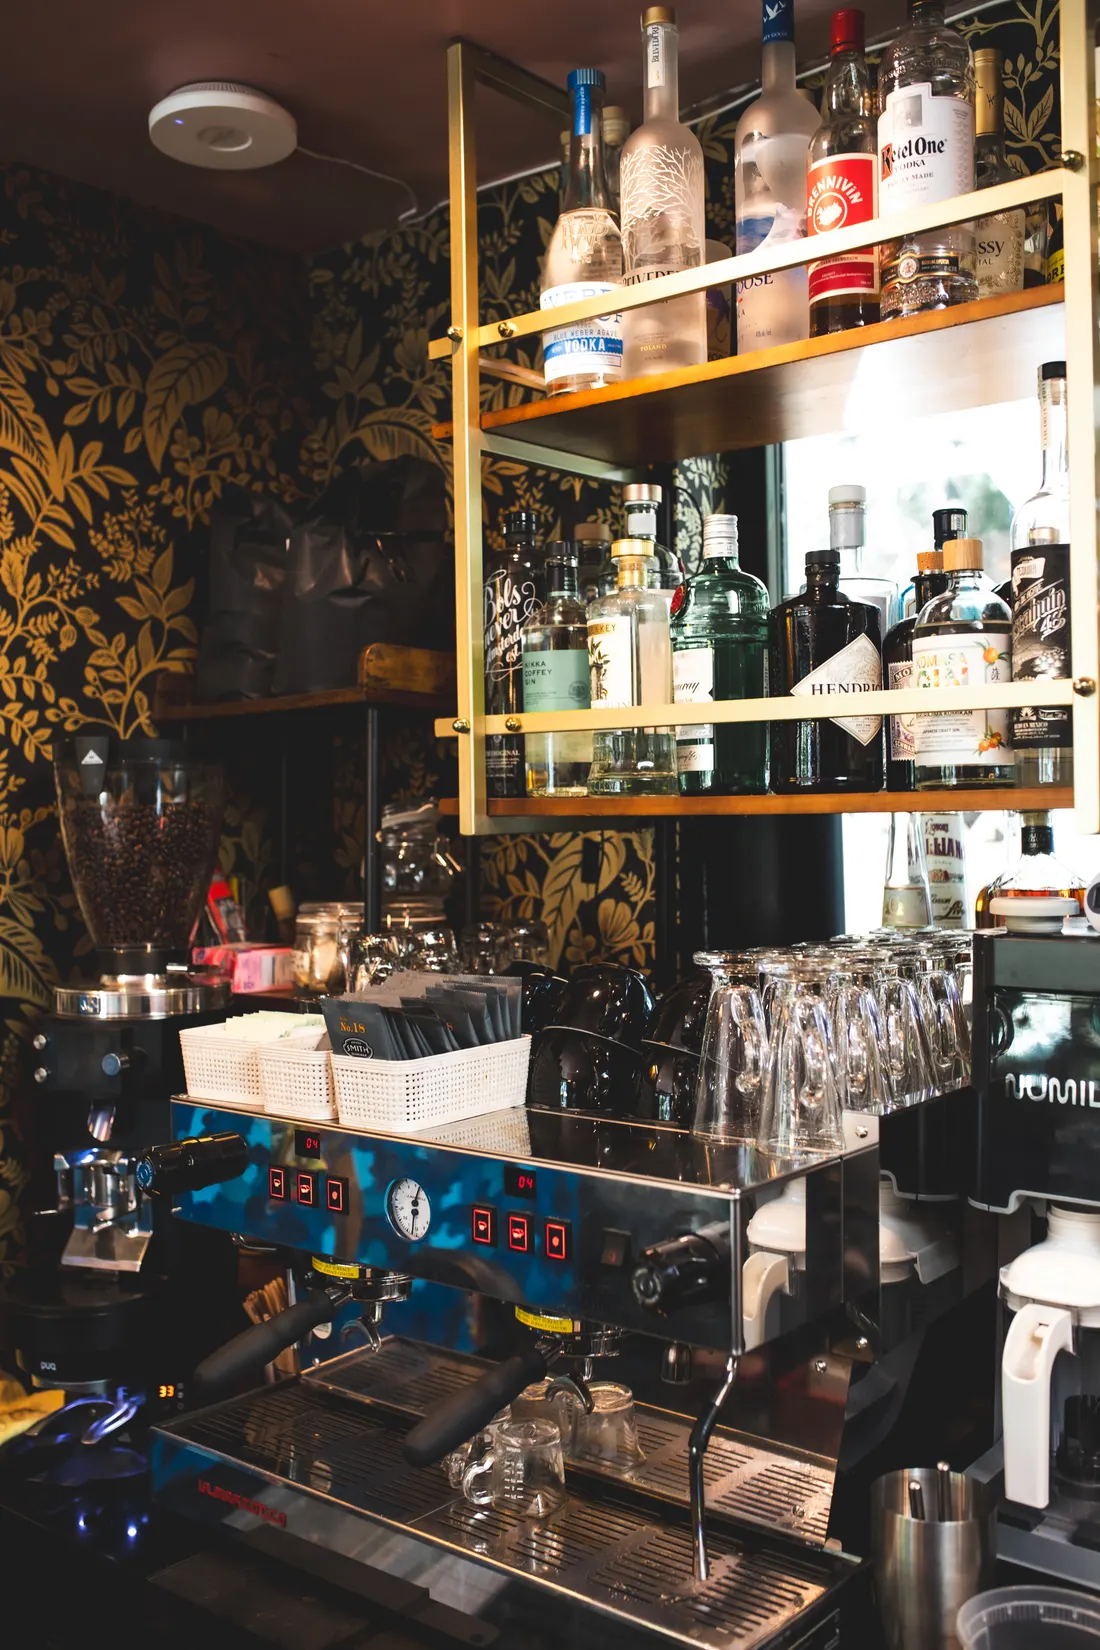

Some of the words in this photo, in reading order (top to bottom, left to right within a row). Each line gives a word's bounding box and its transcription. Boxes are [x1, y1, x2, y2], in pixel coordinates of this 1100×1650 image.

[881, 140, 913, 176] Ketel
[914, 136, 945, 156] One
[911, 172, 934, 181] MADE
[553, 332, 567, 341] BLUE
[571, 329, 594, 337] WEBER
[597, 328, 617, 337] AGAVE
[564, 338, 606, 353] VODKA
[640, 343, 667, 352] POLAND
[525, 669, 552, 677] COFFEY
[346, 1044, 370, 1054] SMITH
[305, 1137, 319, 1149] 04
[518, 1176, 533, 1189] 04
[159, 1384, 175, 1398] 33
